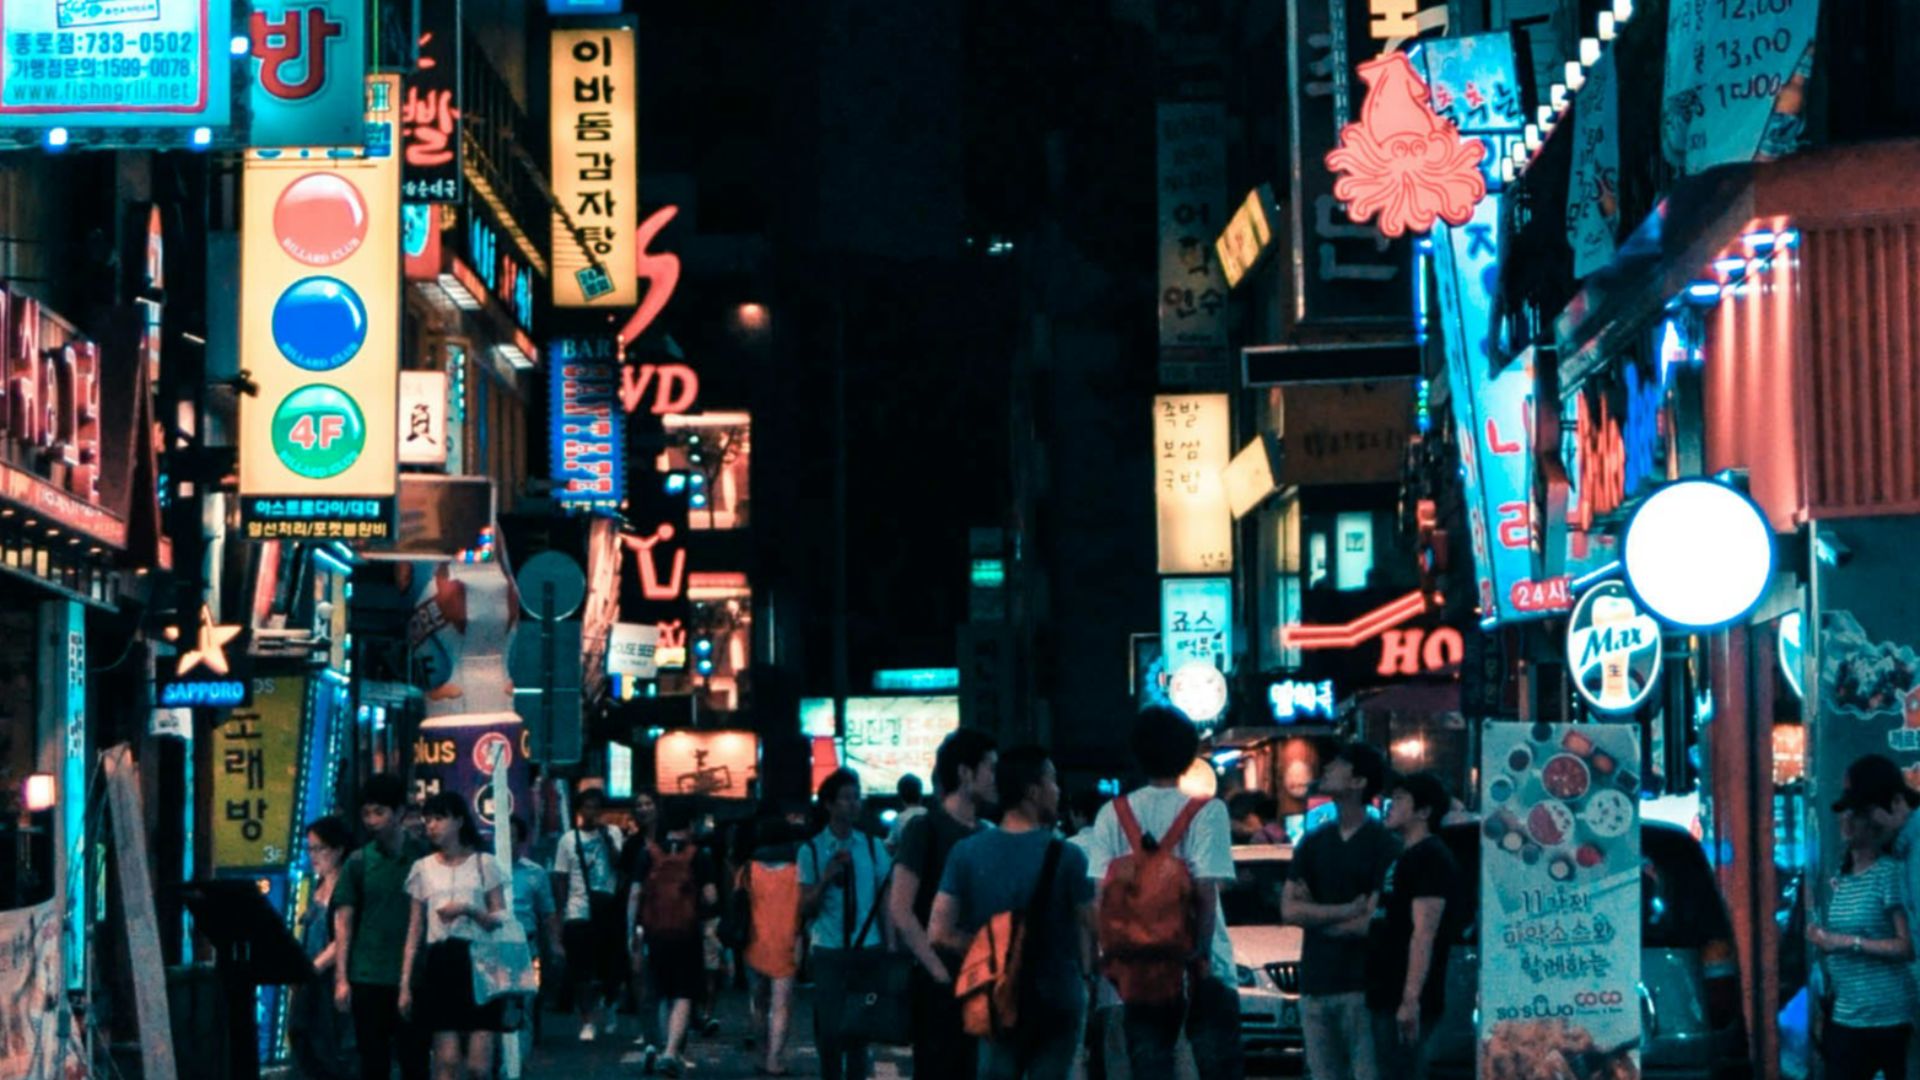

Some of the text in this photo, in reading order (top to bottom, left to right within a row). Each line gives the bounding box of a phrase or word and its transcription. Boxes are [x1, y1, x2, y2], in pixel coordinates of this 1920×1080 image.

[250, 7, 343, 100] 방
[290, 415, 346, 449] 4F
[1579, 626, 1642, 667] Max
[163, 682, 245, 702] SAPPORO
